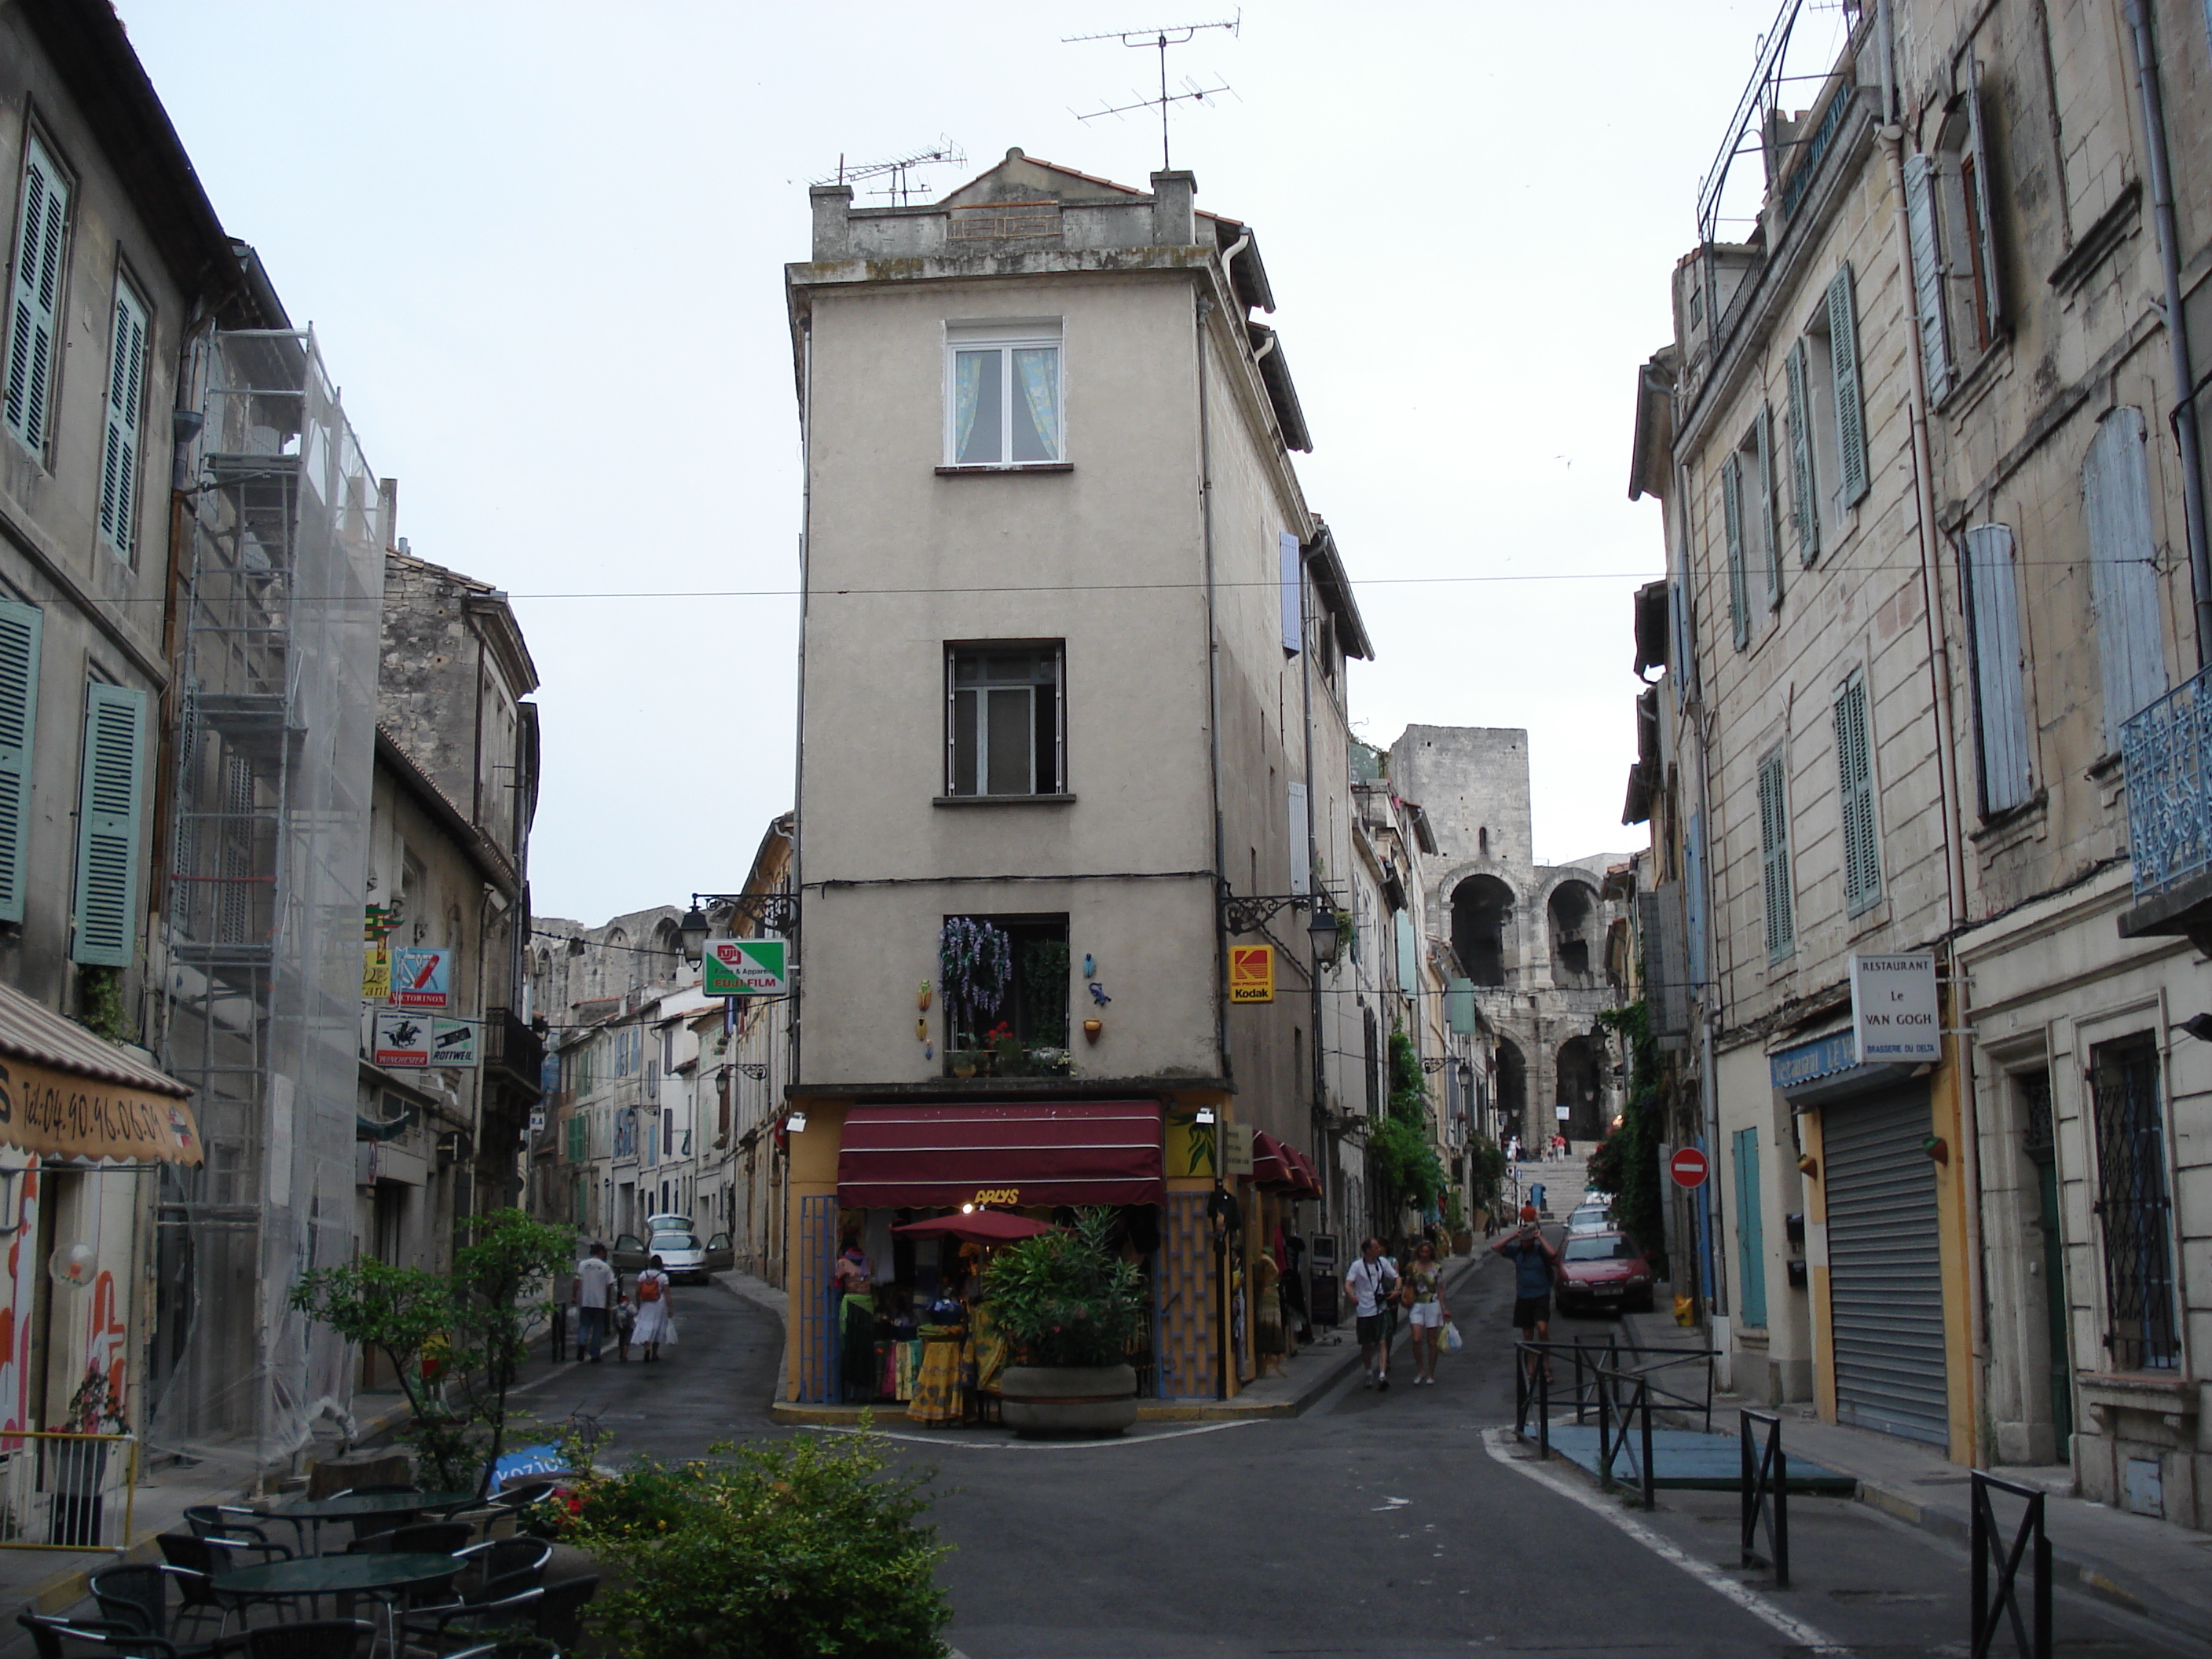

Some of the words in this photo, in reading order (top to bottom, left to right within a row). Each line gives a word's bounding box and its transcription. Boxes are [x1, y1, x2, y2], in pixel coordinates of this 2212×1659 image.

[1862, 961, 1928, 972] RESTAURANT
[715, 979, 744, 987] FUJI
[747, 979, 776, 987] FILM
[392, 992, 444, 1003] VCTORINOX
[1235, 989, 1269, 998] Kodak
[1891, 991, 1904, 1002] Le
[1866, 1014, 1890, 1025] VAN
[1896, 1014, 1932, 1025] GOGH
[1867, 1045, 1901, 1053] BRASSERIE
[1916, 1044, 1935, 1053] DELTA
[379, 1055, 425, 1064] WINCHESTER
[434, 1051, 472, 1060] ROTTWEIL
